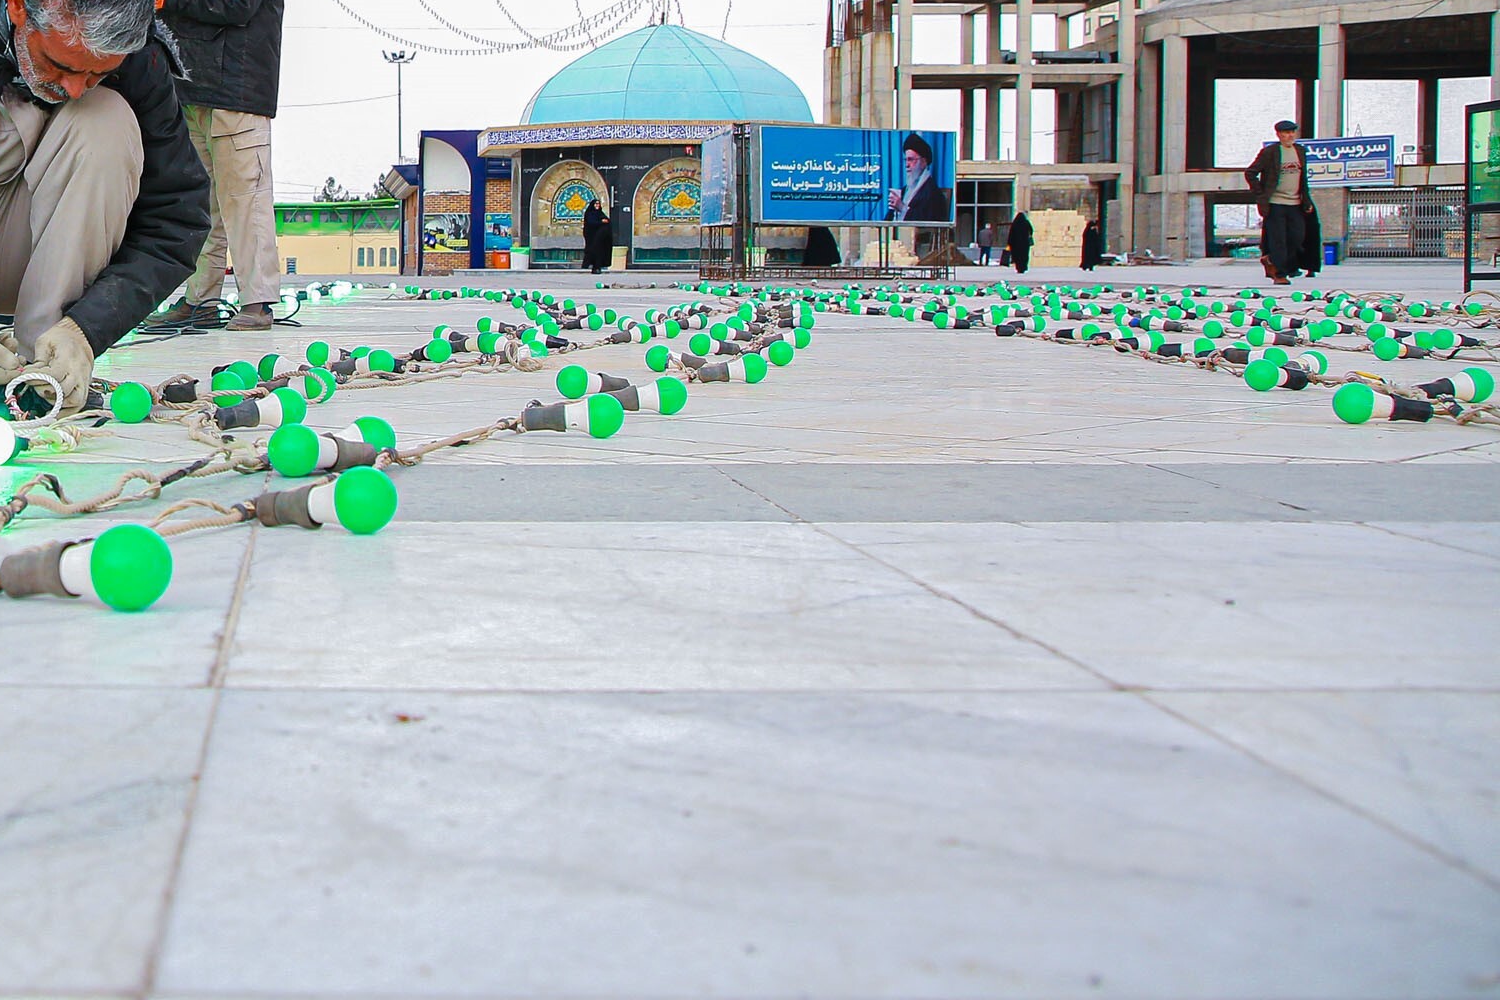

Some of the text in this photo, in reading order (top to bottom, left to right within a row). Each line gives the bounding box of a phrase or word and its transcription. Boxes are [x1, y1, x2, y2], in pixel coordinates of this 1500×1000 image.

[1328, 143, 1387, 160] سرویس
[771, 159, 881, 175] خواست آمریکا مذاکره نیست
[1308, 164, 1342, 178] بانو
[1348, 170, 1363, 178] WC
[771, 177, 791, 187] است
[842, 178, 880, 192] تحمیل
